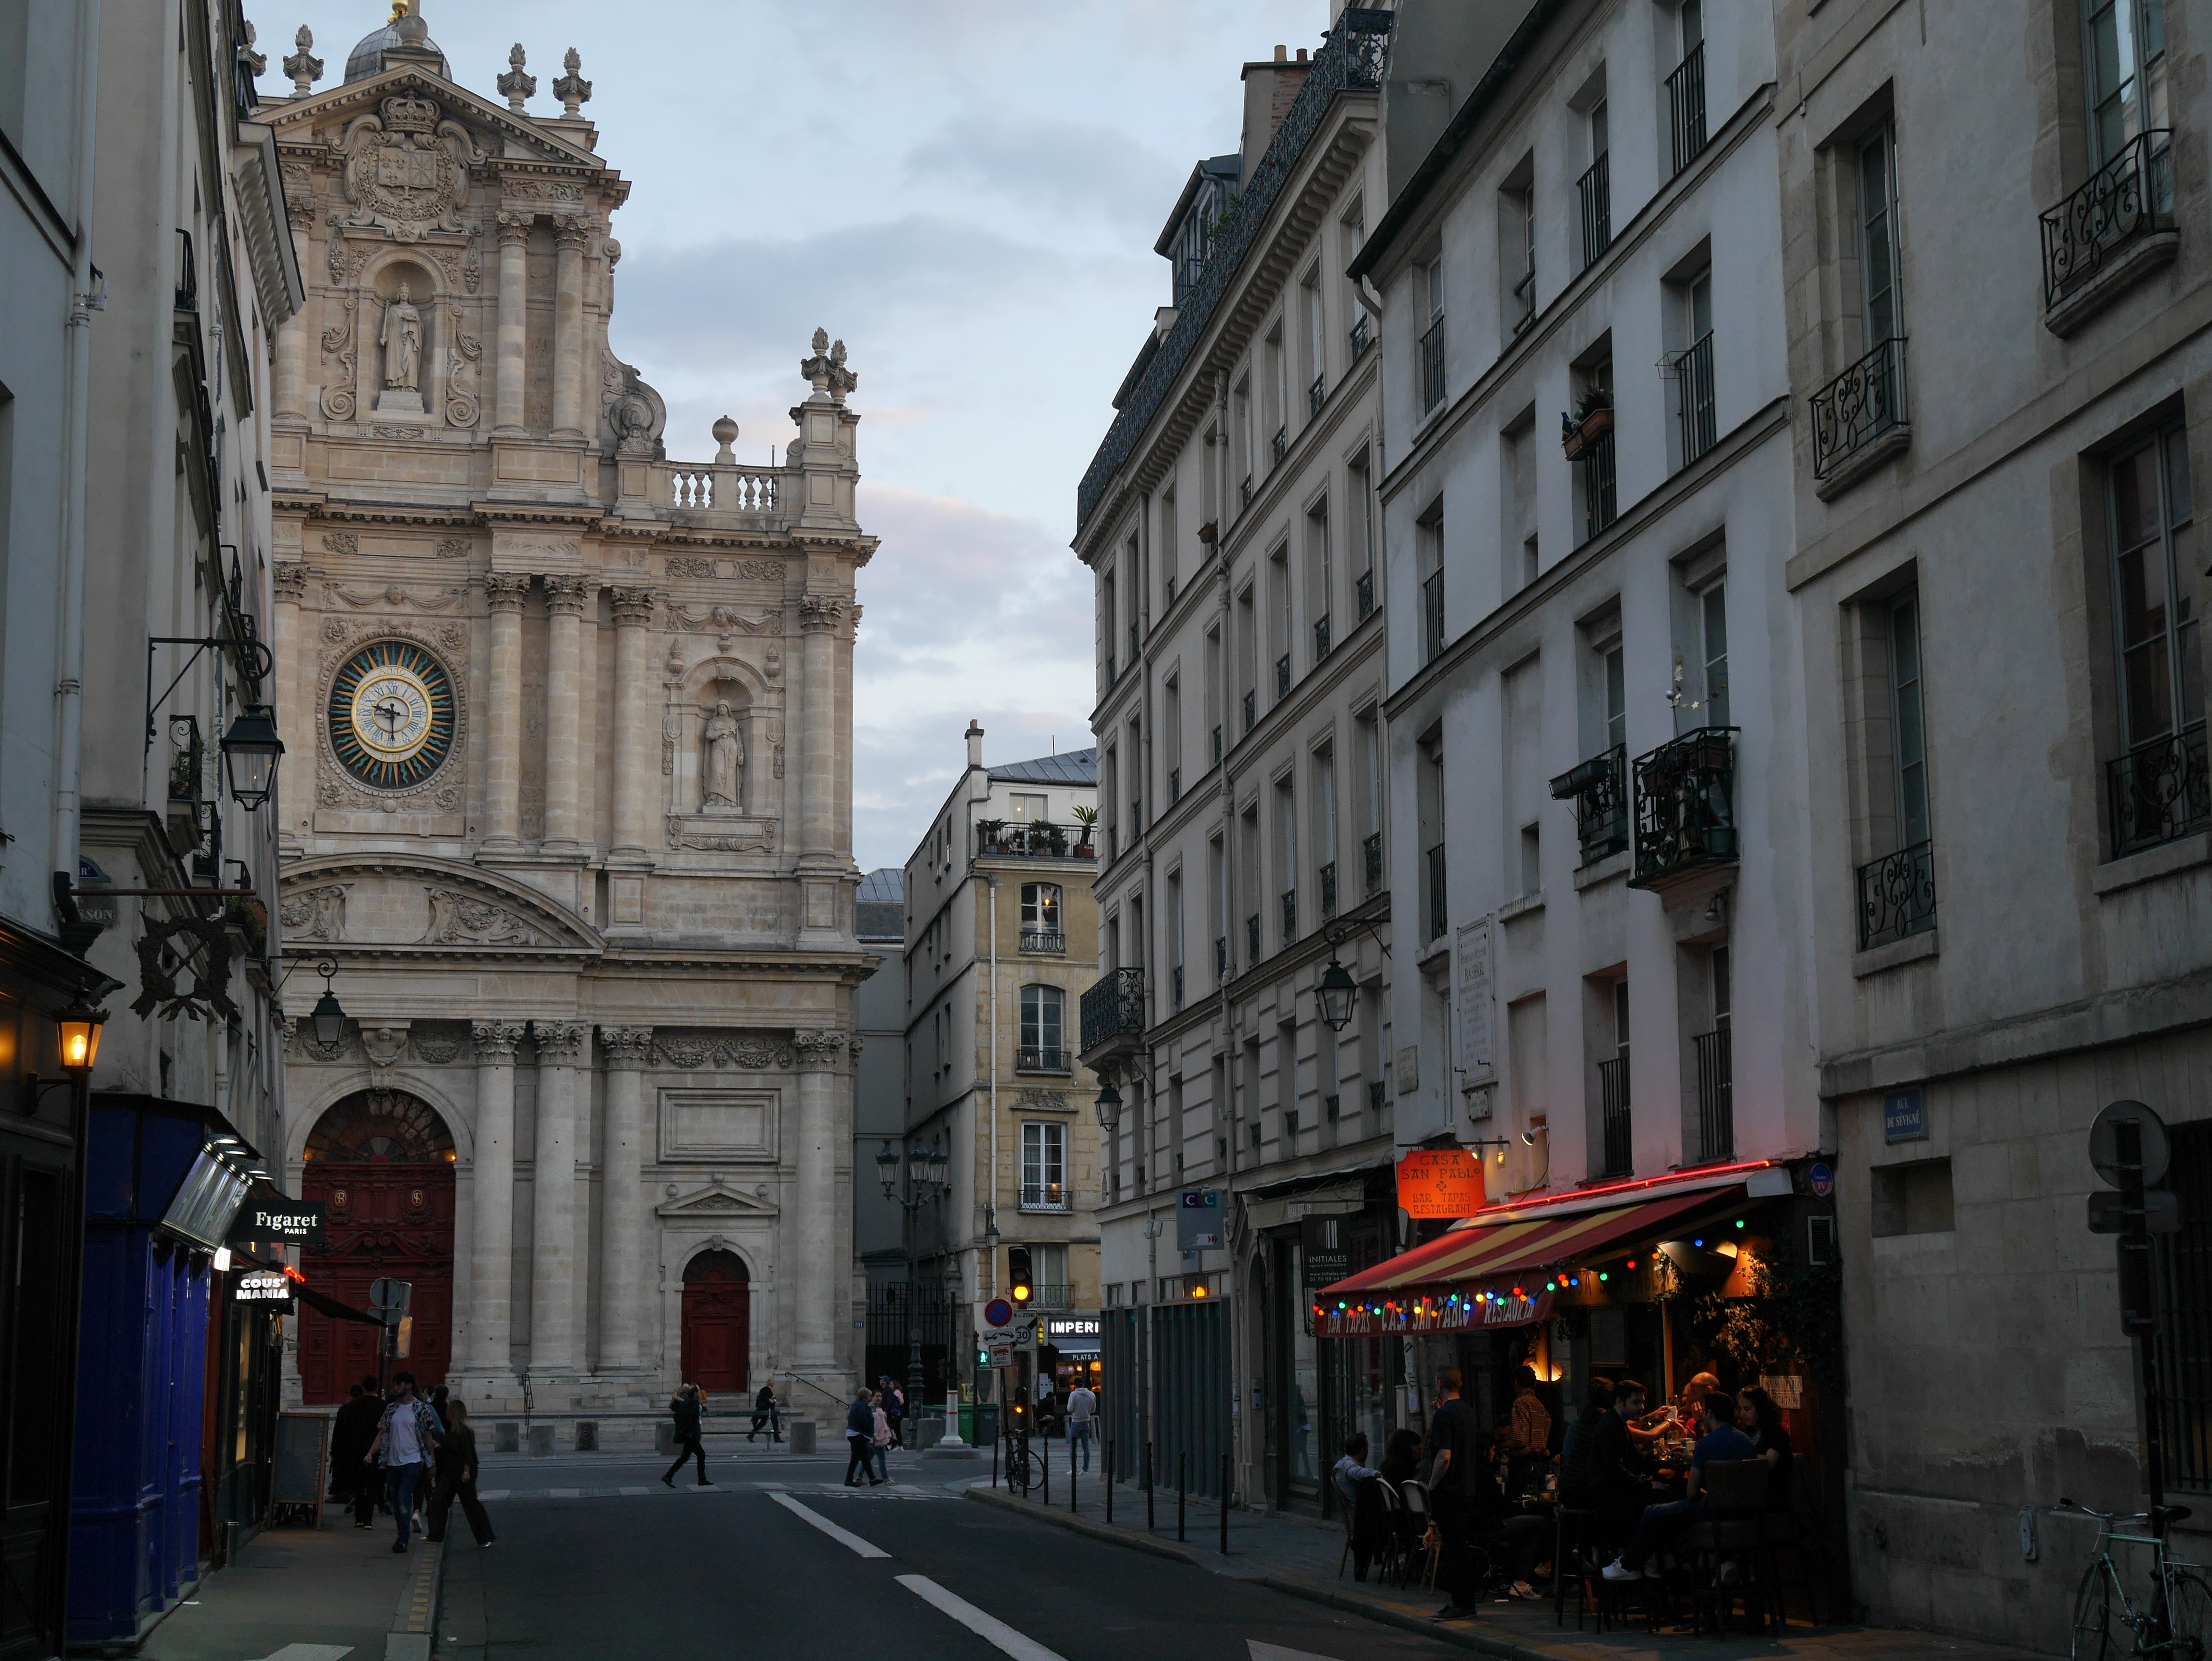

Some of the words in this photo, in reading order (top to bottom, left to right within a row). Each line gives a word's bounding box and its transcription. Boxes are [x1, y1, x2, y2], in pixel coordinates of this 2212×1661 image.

[379, 667, 405, 675] ANNO
[1464, 962, 1484, 982] RASPAIL
[1897, 1098, 1909, 1109] RUE
[1887, 1117, 1895, 1128] DE
[1896, 1110, 1920, 1126] SÉVIGNÉ
[1420, 1154, 1460, 1165] CASA
[1402, 1168, 1429, 1179] SAN
[1439, 1168, 1480, 1179] PABLO
[1413, 1193, 1432, 1202] BAR
[1442, 1192, 1471, 1202] TAPAS
[1413, 1204, 1471, 1214] RESTAURANT
[255, 1212, 317, 1230] Figaret
[1309, 1255, 1347, 1263] INITIALES
[240, 1278, 286, 1289] COUS'
[236, 1289, 289, 1300] MANIA
[1051, 1322, 1099, 1333] IMPERI
[1327, 1313, 1341, 1333] BAR
[1346, 1311, 1371, 1333] TAPAS
